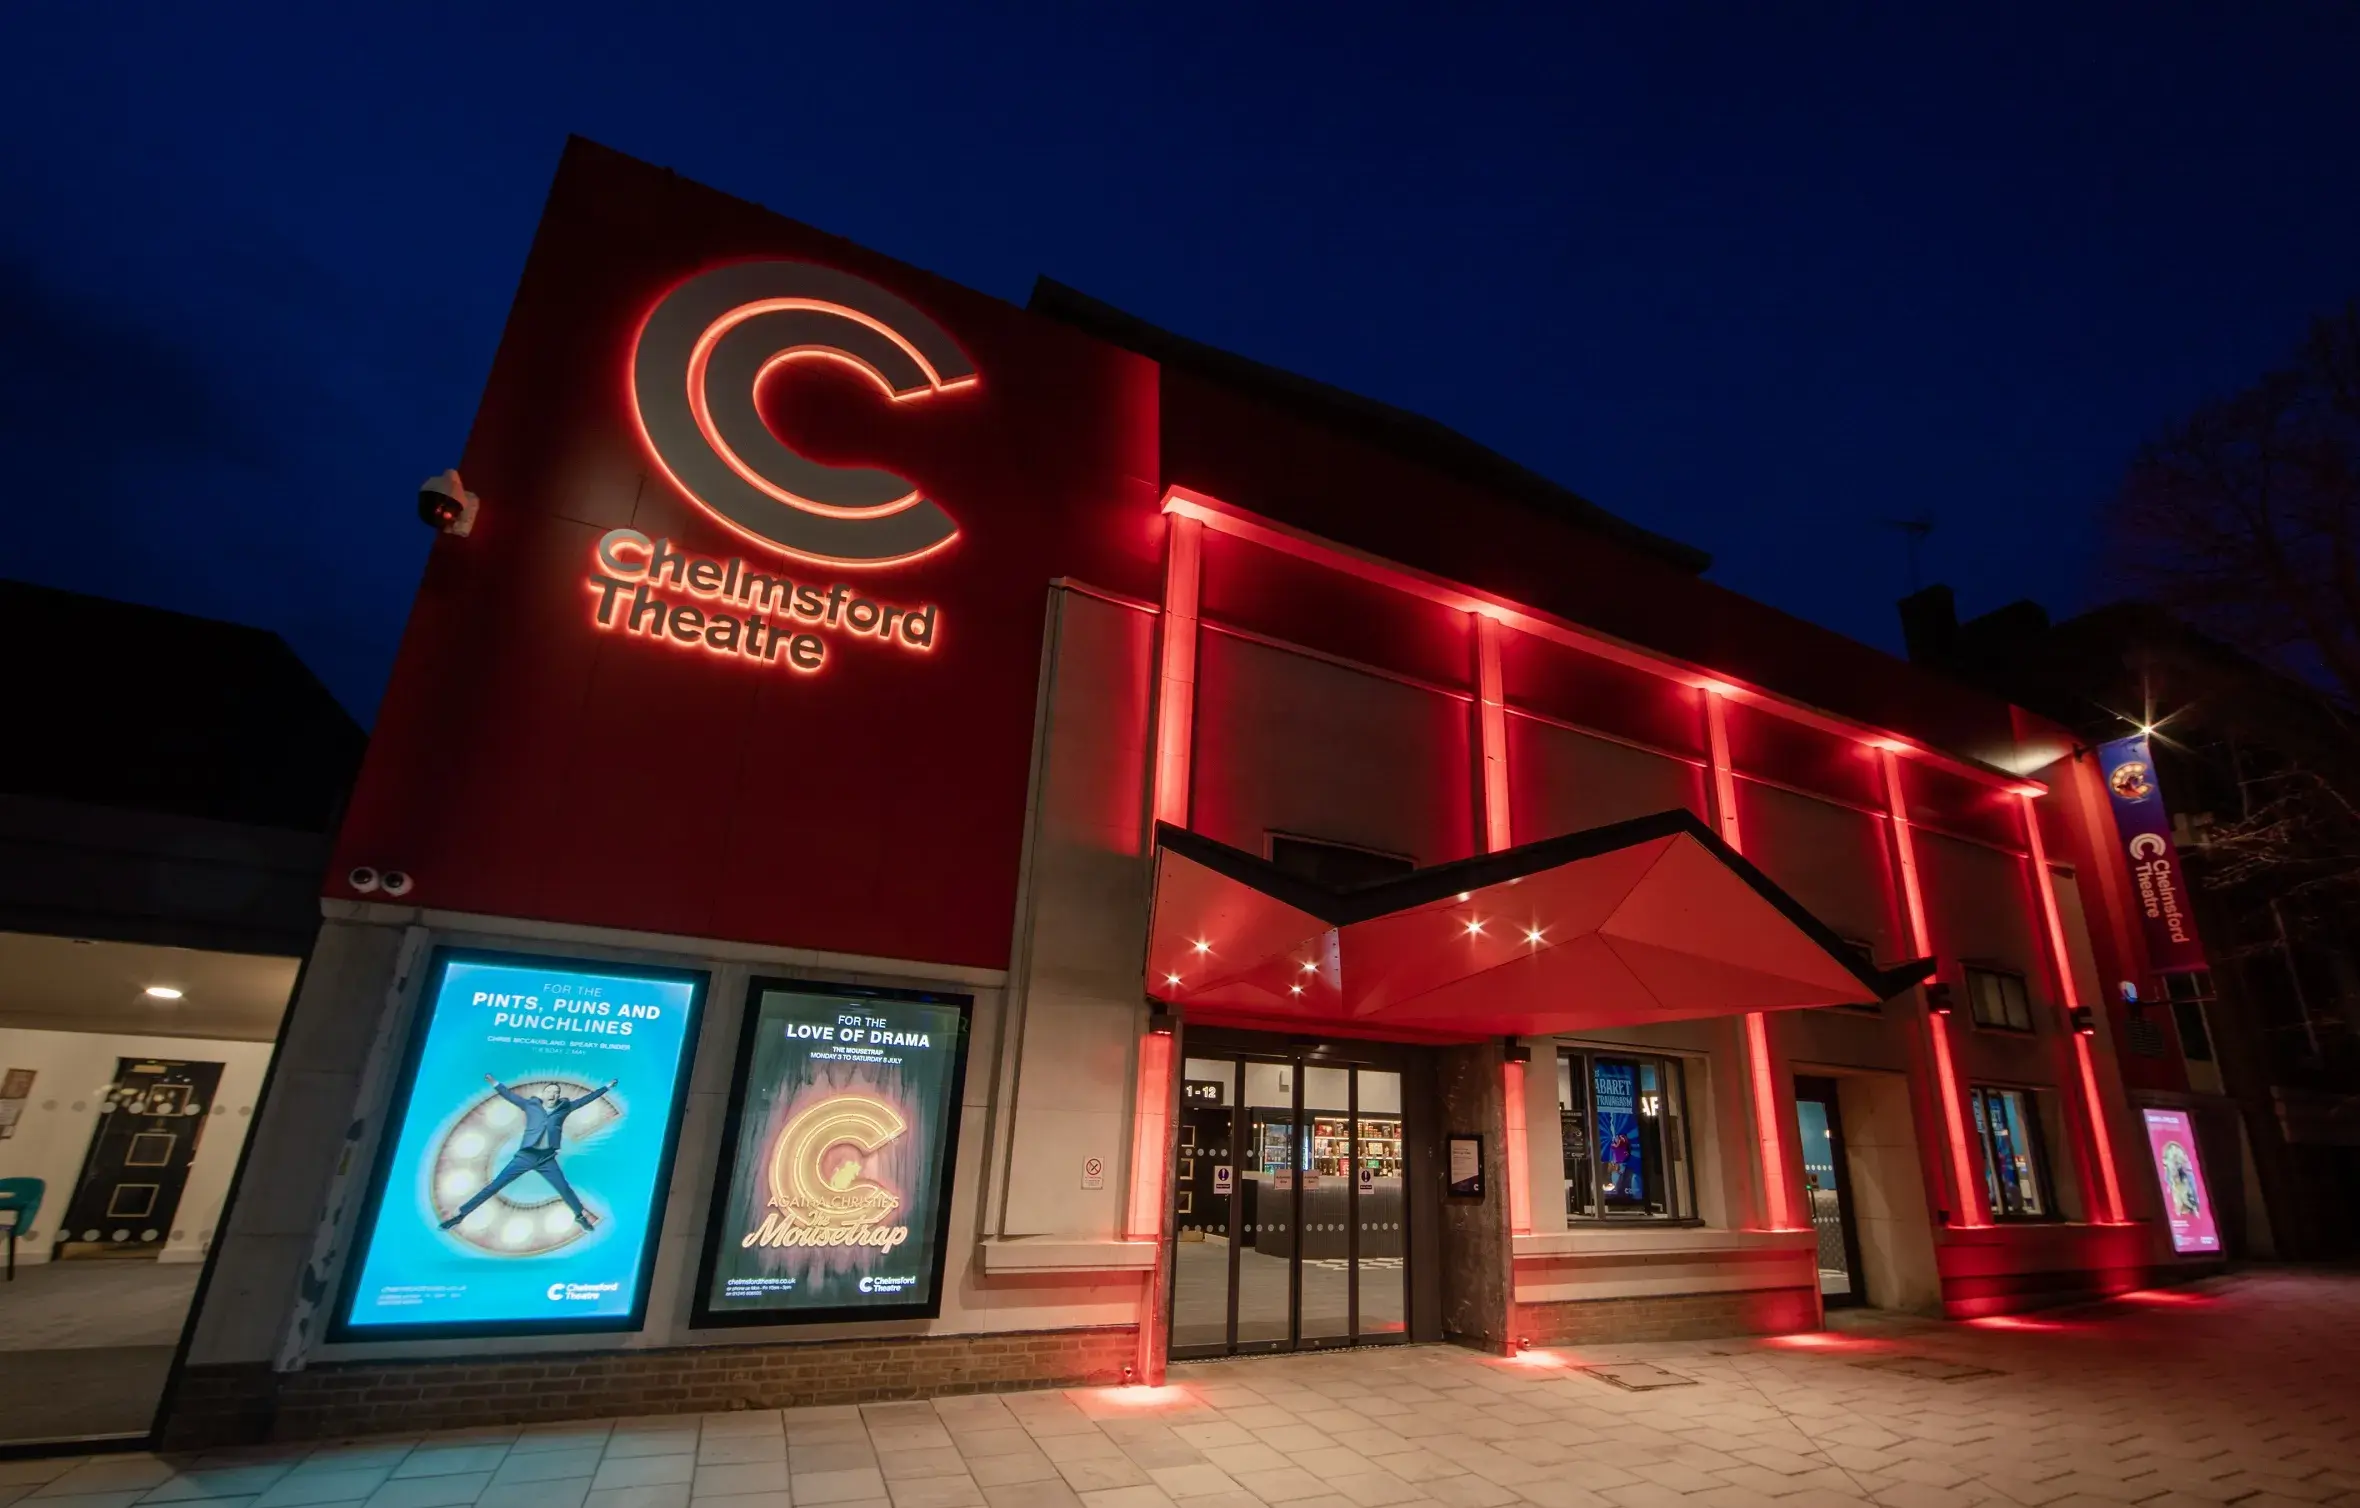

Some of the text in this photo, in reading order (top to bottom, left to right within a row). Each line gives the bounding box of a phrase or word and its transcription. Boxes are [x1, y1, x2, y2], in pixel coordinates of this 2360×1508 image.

[598, 527, 938, 649] Chelmsford
[588, 574, 826, 671] Theatre
[2135, 862, 2160, 919] Theatre
[2153, 859, 2190, 944] Chelmsford
[543, 983, 603, 998] FOR THE
[472, 991, 661, 1021] PINTS, PUNS AND
[494, 1013, 634, 1036] PUNCHLINES
[838, 1015, 887, 1029] FOR THE
[786, 1024, 930, 1048] LOVE OF DRAMA
[810, 1052, 836, 1060] MONDAY
[852, 1055, 883, 1063] SATURDAY
[833, 1046, 884, 1056] THE MOUSETRAP
[1202, 1086, 1216, 1098] 12
[1595, 1078, 1632, 1096] ABARET
[767, 1195, 900, 1209] AGATHA CHRISTIE'S
[807, 1210, 831, 1227] The
[742, 1213, 908, 1254] Mousetrap
[873, 1284, 902, 1292] Theatre
[874, 1275, 916, 1285] Chelmsford
